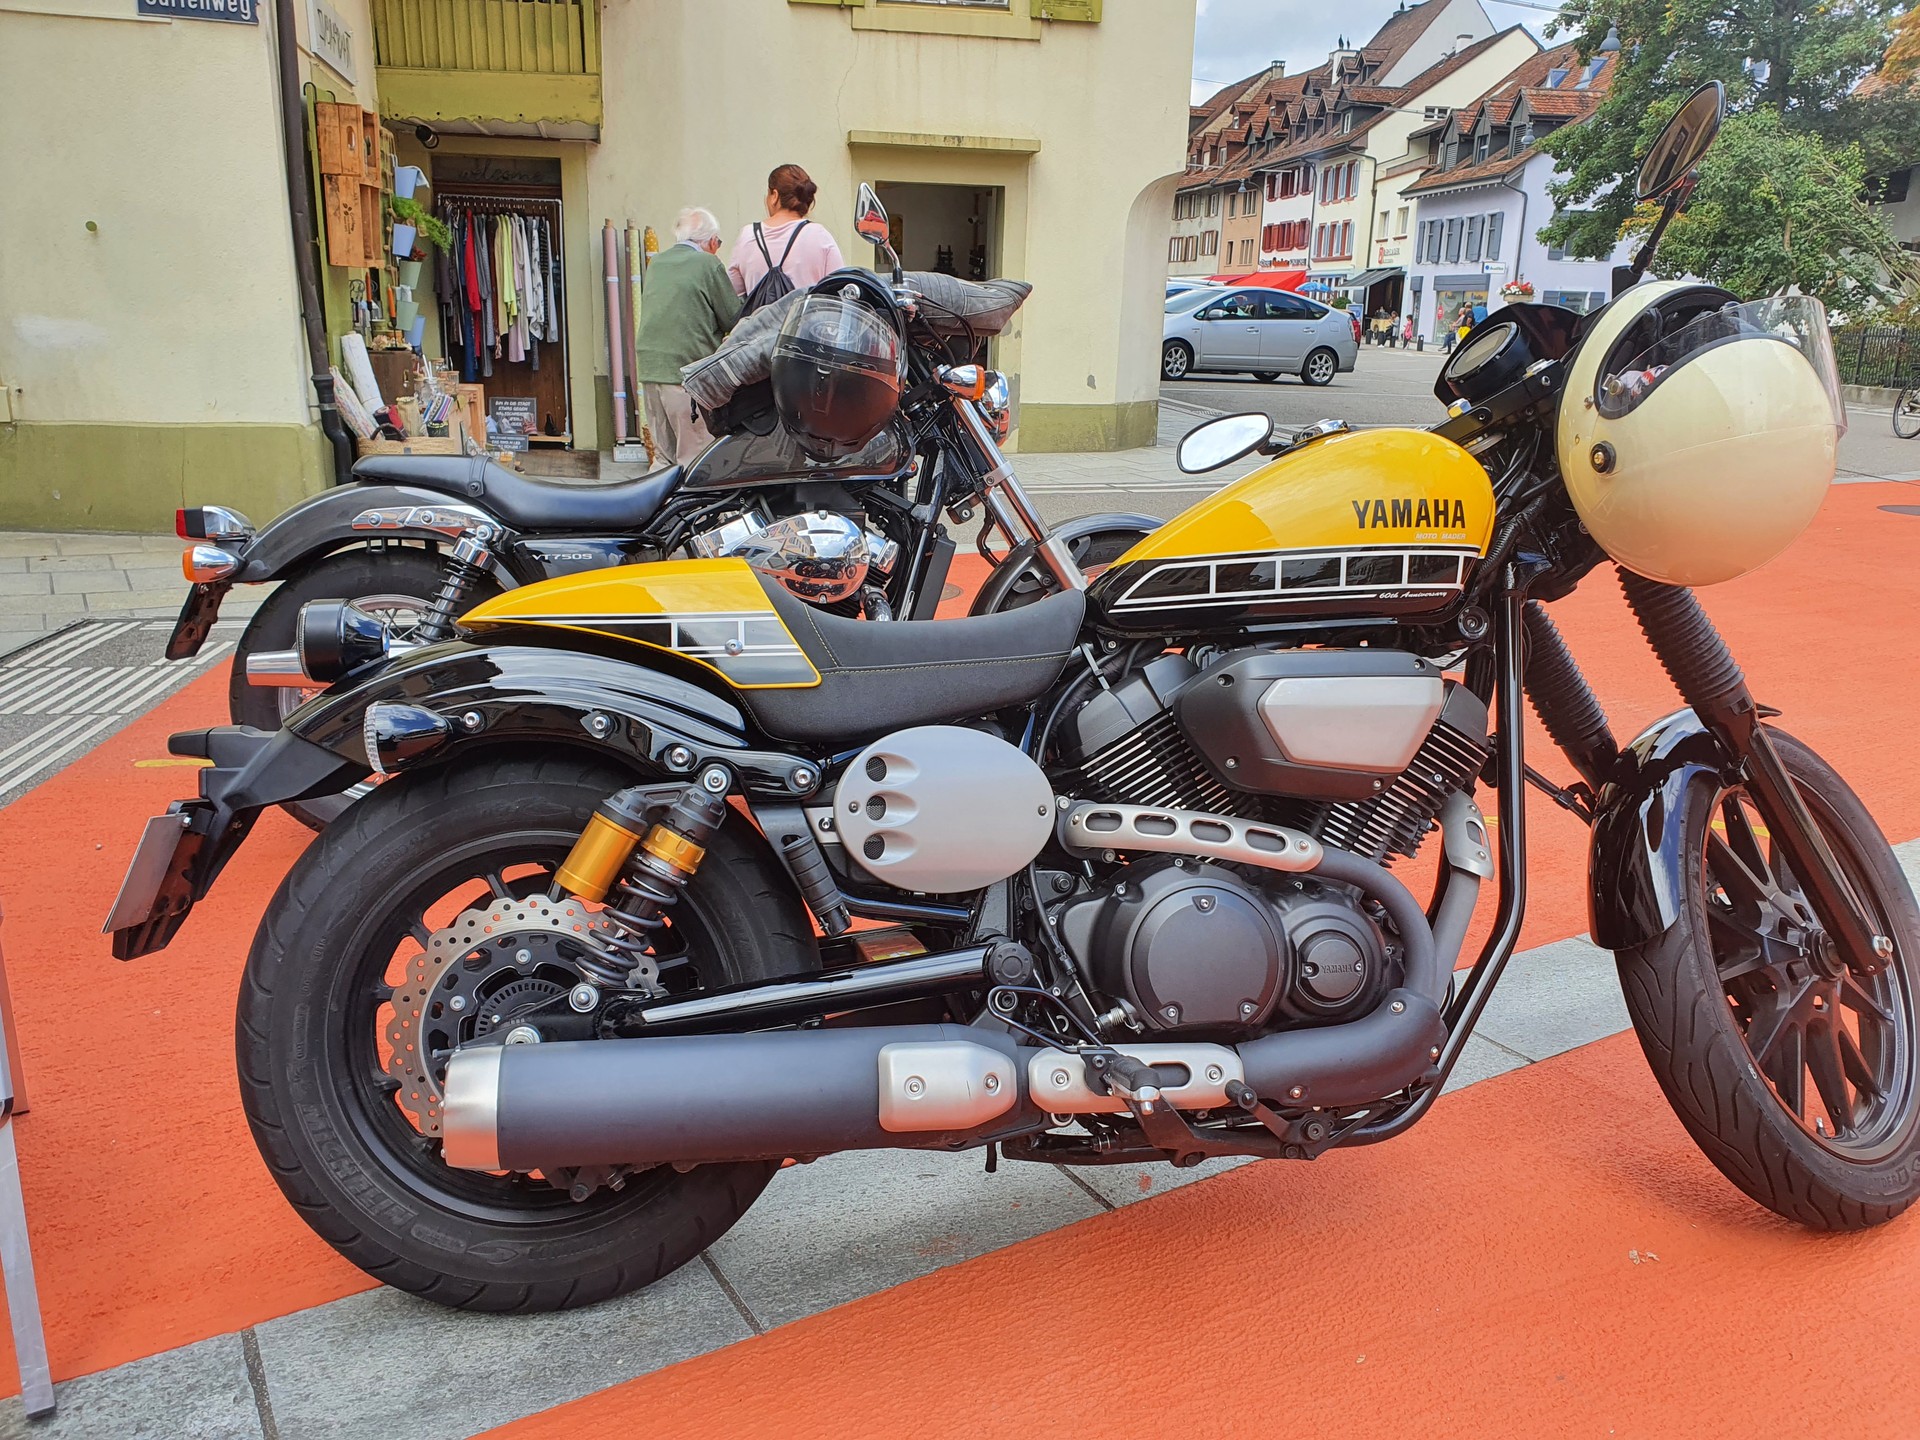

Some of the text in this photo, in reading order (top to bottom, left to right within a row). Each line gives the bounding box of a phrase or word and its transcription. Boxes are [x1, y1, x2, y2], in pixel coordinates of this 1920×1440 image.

[145, 0, 251, 20] enweg
[1351, 498, 1466, 529] YAMAHA
[1415, 532, 1466, 540] MOTO MADER
[531, 553, 593, 561] VT750S
[1379, 591, 1448, 599] 60th Anniversary
[1320, 964, 1354, 974] YAMAHA
